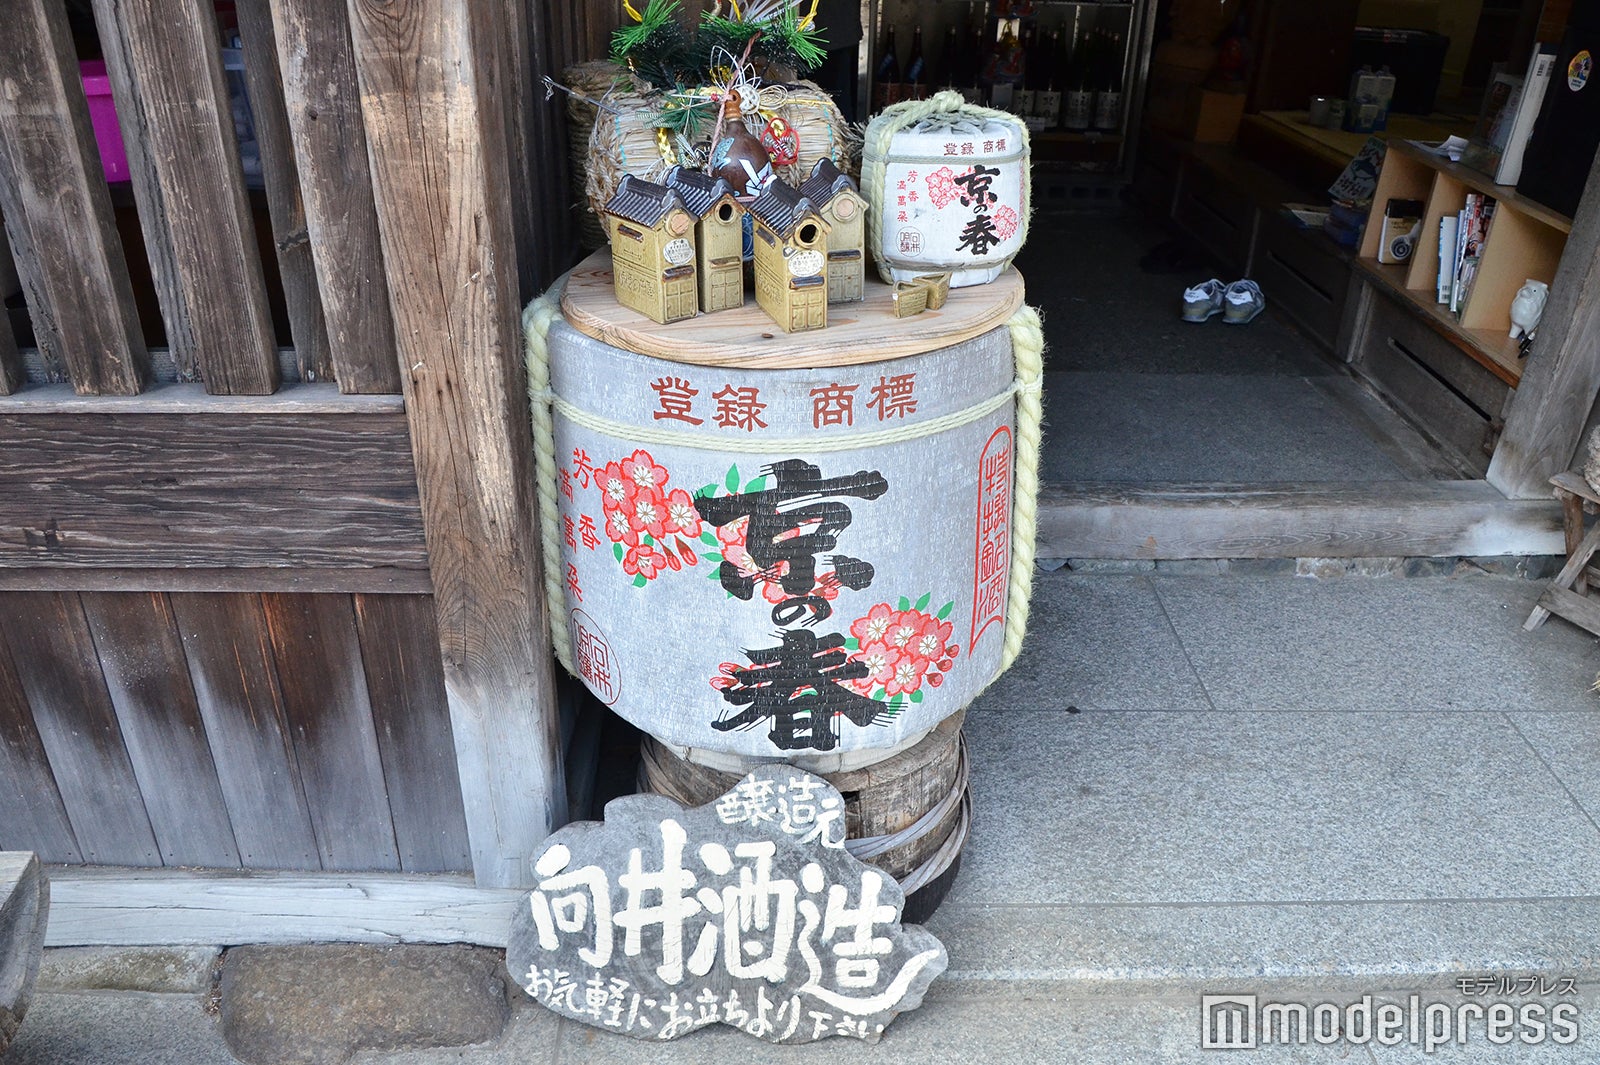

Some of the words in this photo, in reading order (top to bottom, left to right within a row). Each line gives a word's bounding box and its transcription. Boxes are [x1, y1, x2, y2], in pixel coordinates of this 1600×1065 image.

[943, 138, 1007, 156] 登録商標
[954, 164, 1001, 255] 京の春
[650, 372, 918, 433] 登録商標
[573, 447, 602, 551] 芳香
[692, 458, 909, 751] 京の春
[715, 773, 846, 850] 醸造元
[530, 818, 940, 1016] 向井酒造
[524, 964, 886, 1044] お気軽にお立ちより下さい
